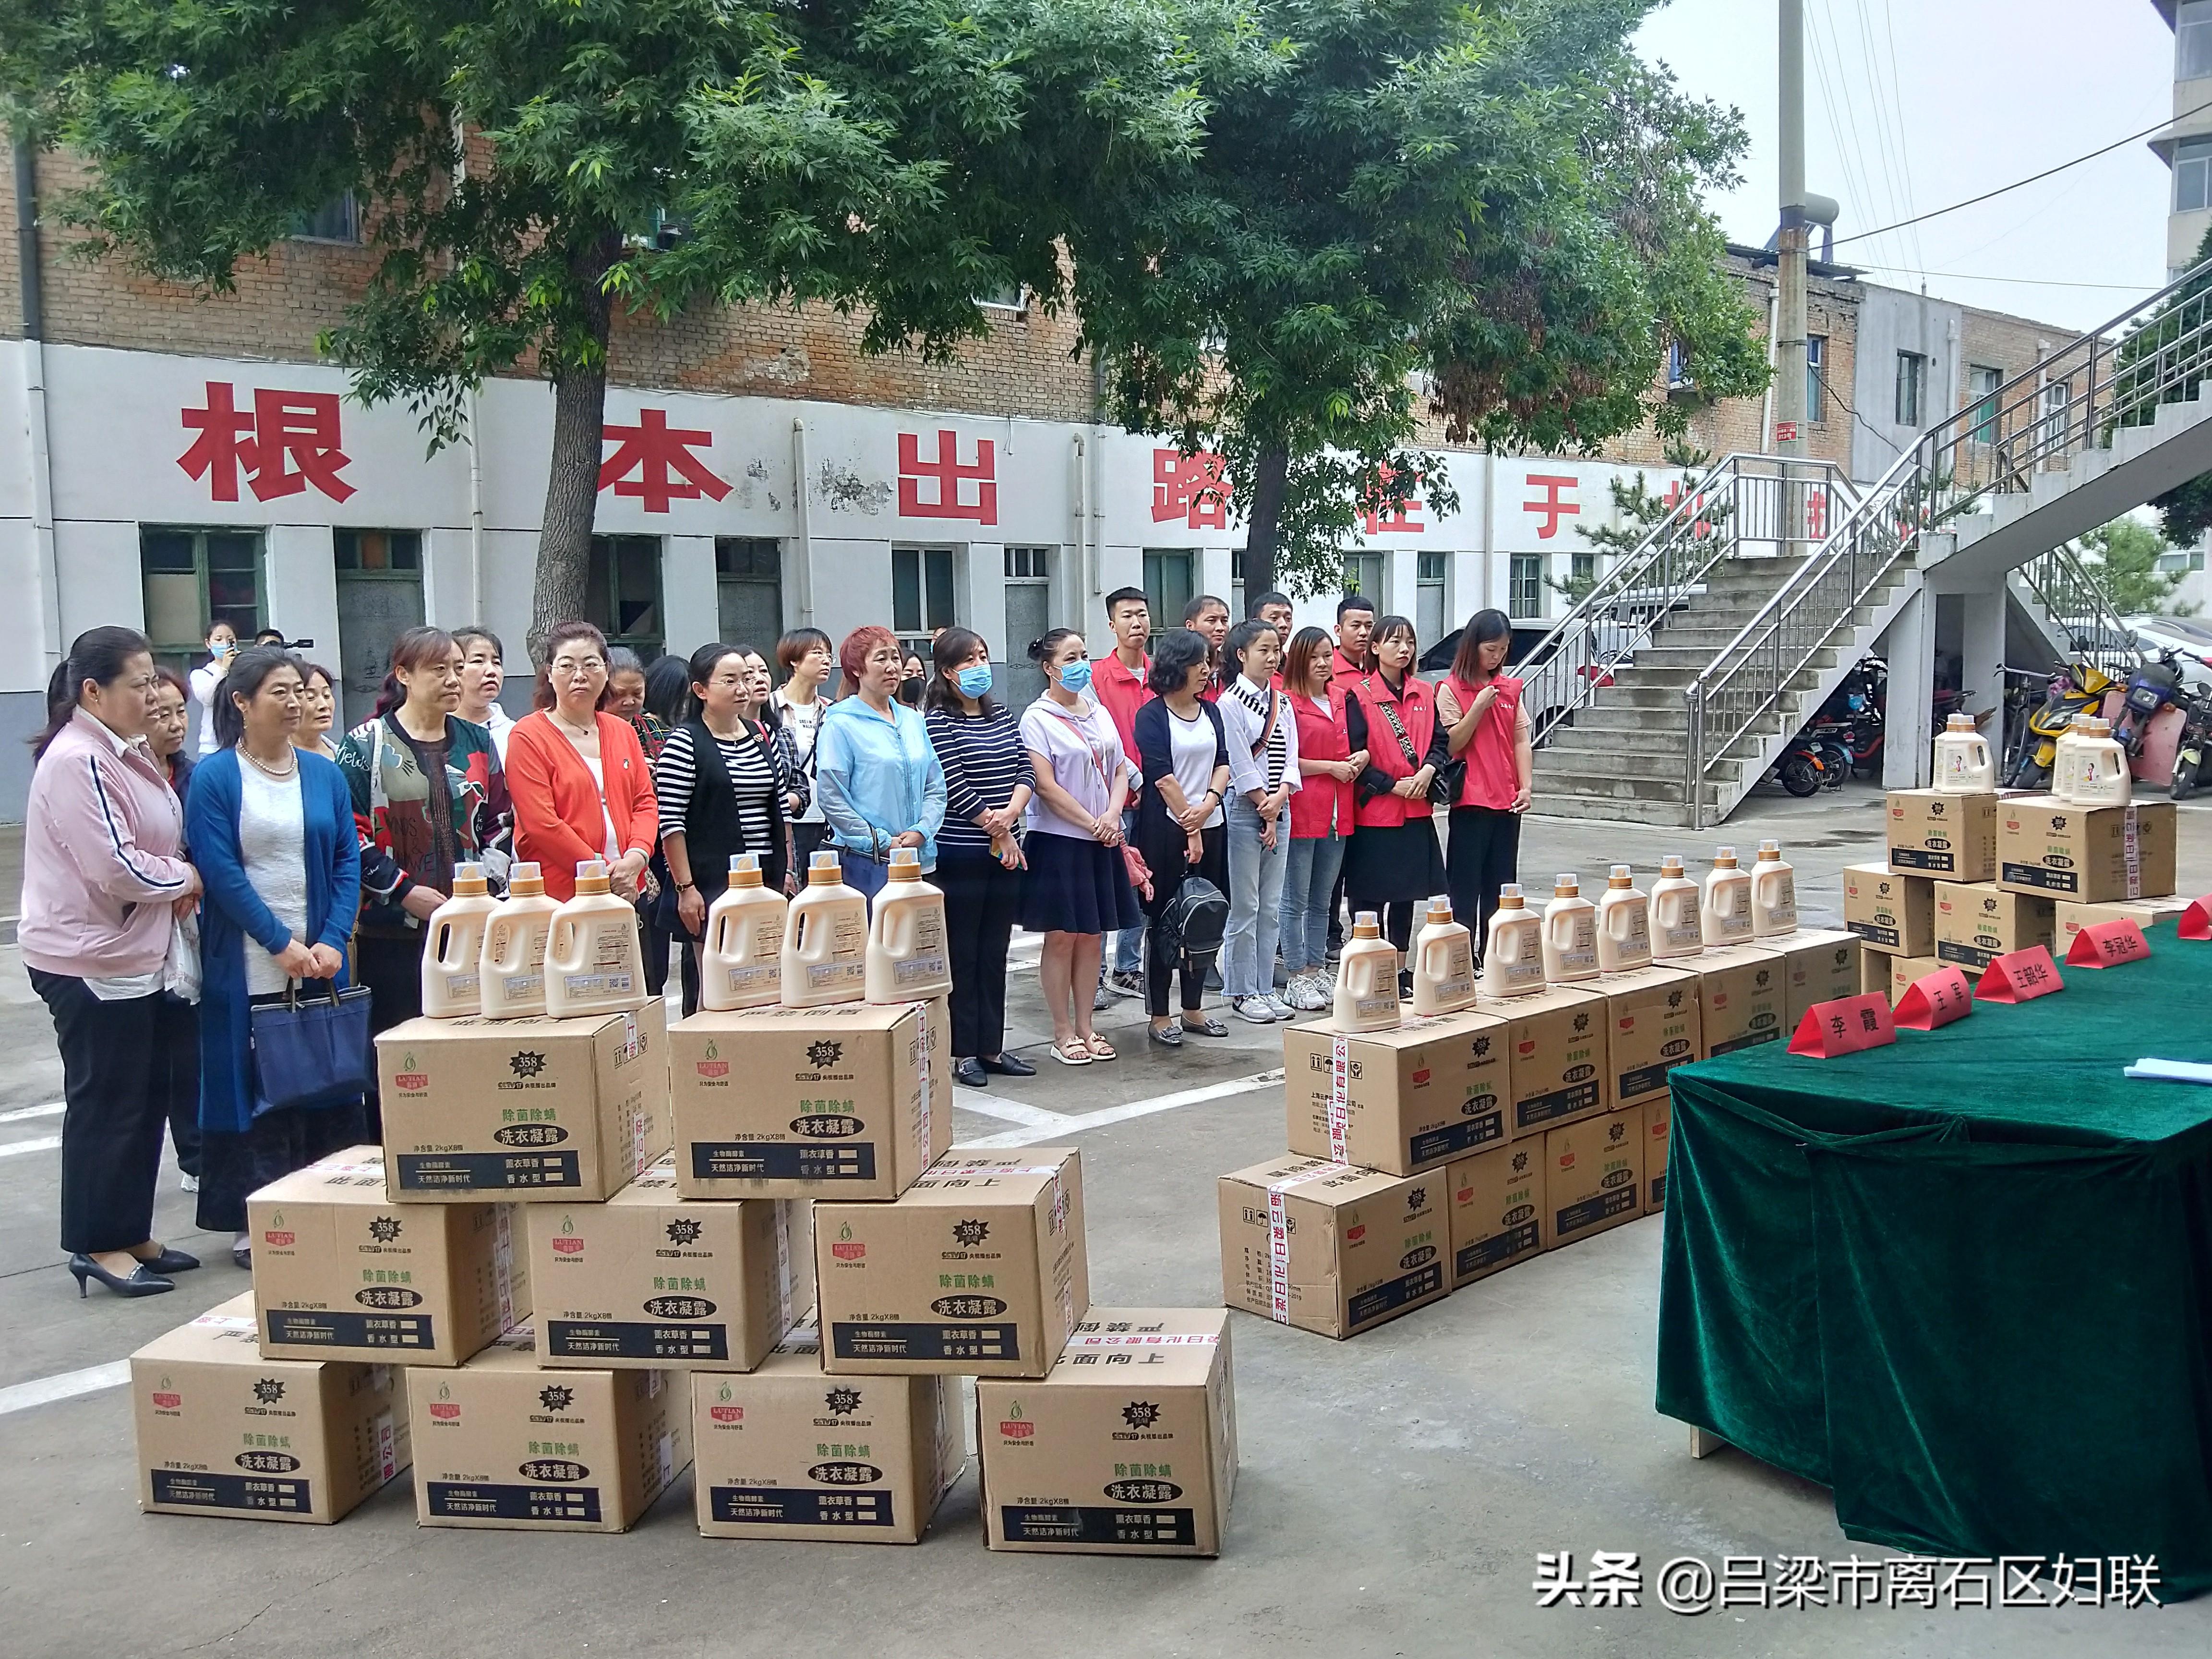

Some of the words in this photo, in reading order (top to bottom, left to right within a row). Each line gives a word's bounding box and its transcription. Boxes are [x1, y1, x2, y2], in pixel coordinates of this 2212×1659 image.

[177, 381, 358, 504] 根
[597, 408, 734, 514] 本
[897, 429, 998, 526] 出
[1150, 447, 1235, 530] 路
[1523, 473, 1581, 539] 于
[2102, 935, 2139, 956] 李冠华
[816, 1046, 834, 1057] 358
[519, 1057, 537, 1067] 358
[800, 1099, 855, 1114] 除菌除螨
[1465, 1096, 1493, 1114] 洗衣凝露
[503, 1107, 556, 1122] 除菌除螨
[796, 1118, 855, 1135] 洗衣凝露
[501, 1127, 558, 1145] 洗衣凝露
[414, 1144, 433, 1153] 净含量
[800, 1149, 834, 1159] 薰衣草香
[505, 1158, 539, 1169] 薰衣草香
[710, 1164, 764, 1173] 天然洁净新时代
[417, 1174, 470, 1185] 天然洁净新时代
[1412, 1191, 1423, 1202] 358
[675, 1224, 694, 1235] 358
[962, 1226, 980, 1235] 358
[1403, 1247, 1432, 1269] 洗衣凝露
[653, 1277, 707, 1291] 除菌除螨
[940, 1274, 993, 1288] 除菌除螨
[649, 1300, 708, 1316] 洗衣凝露
[938, 1299, 996, 1315] 洗衣凝露
[654, 1330, 687, 1340] 薰衣草香
[943, 1330, 977, 1340] 薰衣草香
[567, 1342, 620, 1351] 天然洁净新时代
[852, 1344, 907, 1354] 天然洁净新时代
[547, 1391, 566, 1402] 358
[834, 1395, 853, 1404] 358
[1131, 1407, 1152, 1418] 358
[528, 1441, 580, 1455] 除菌除螨
[817, 1443, 870, 1457] 除菌除螨
[525, 1463, 580, 1479] 洗衣凝露
[815, 1466, 872, 1482] 洗衣凝露
[1115, 1463, 1172, 1478] 除菌除螨
[530, 1492, 562, 1502] 薰衣草香
[1111, 1484, 1172, 1500] 洗衣凝露
[818, 1496, 852, 1506] 薰衣草香
[446, 1503, 496, 1512] 天然洁净新时代
[730, 1508, 783, 1518] 天然洁净新时代
[1116, 1515, 1151, 1524] 薰衣草香
[1023, 1527, 1079, 1537] 天然洁净新时代
